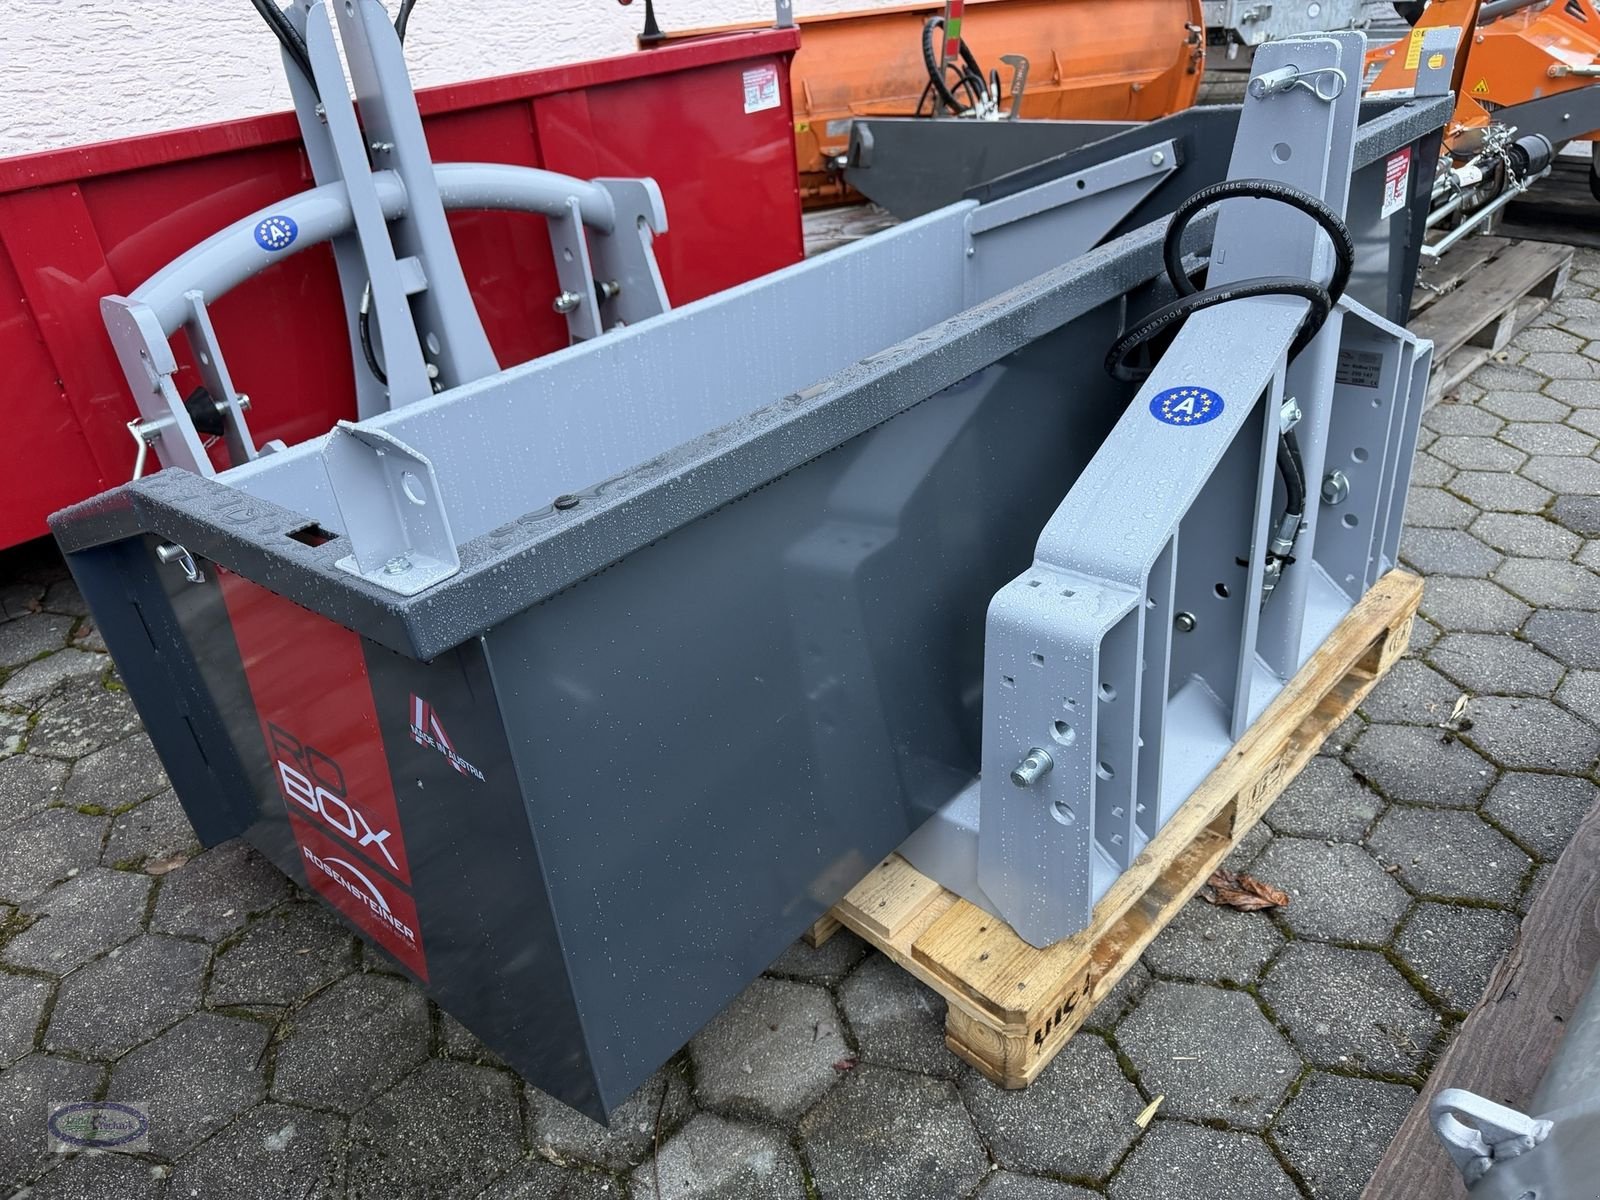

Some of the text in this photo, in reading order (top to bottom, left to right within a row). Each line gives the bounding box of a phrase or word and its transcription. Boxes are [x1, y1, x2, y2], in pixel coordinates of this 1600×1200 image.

[270, 224, 286, 242] A
[1172, 396, 1195, 415] A
[267, 721, 347, 798] RO
[409, 723, 486, 783] MADE IN AUSTRIA
[277, 759, 400, 871] BOX
[302, 845, 416, 943] ROSENSTEINER
